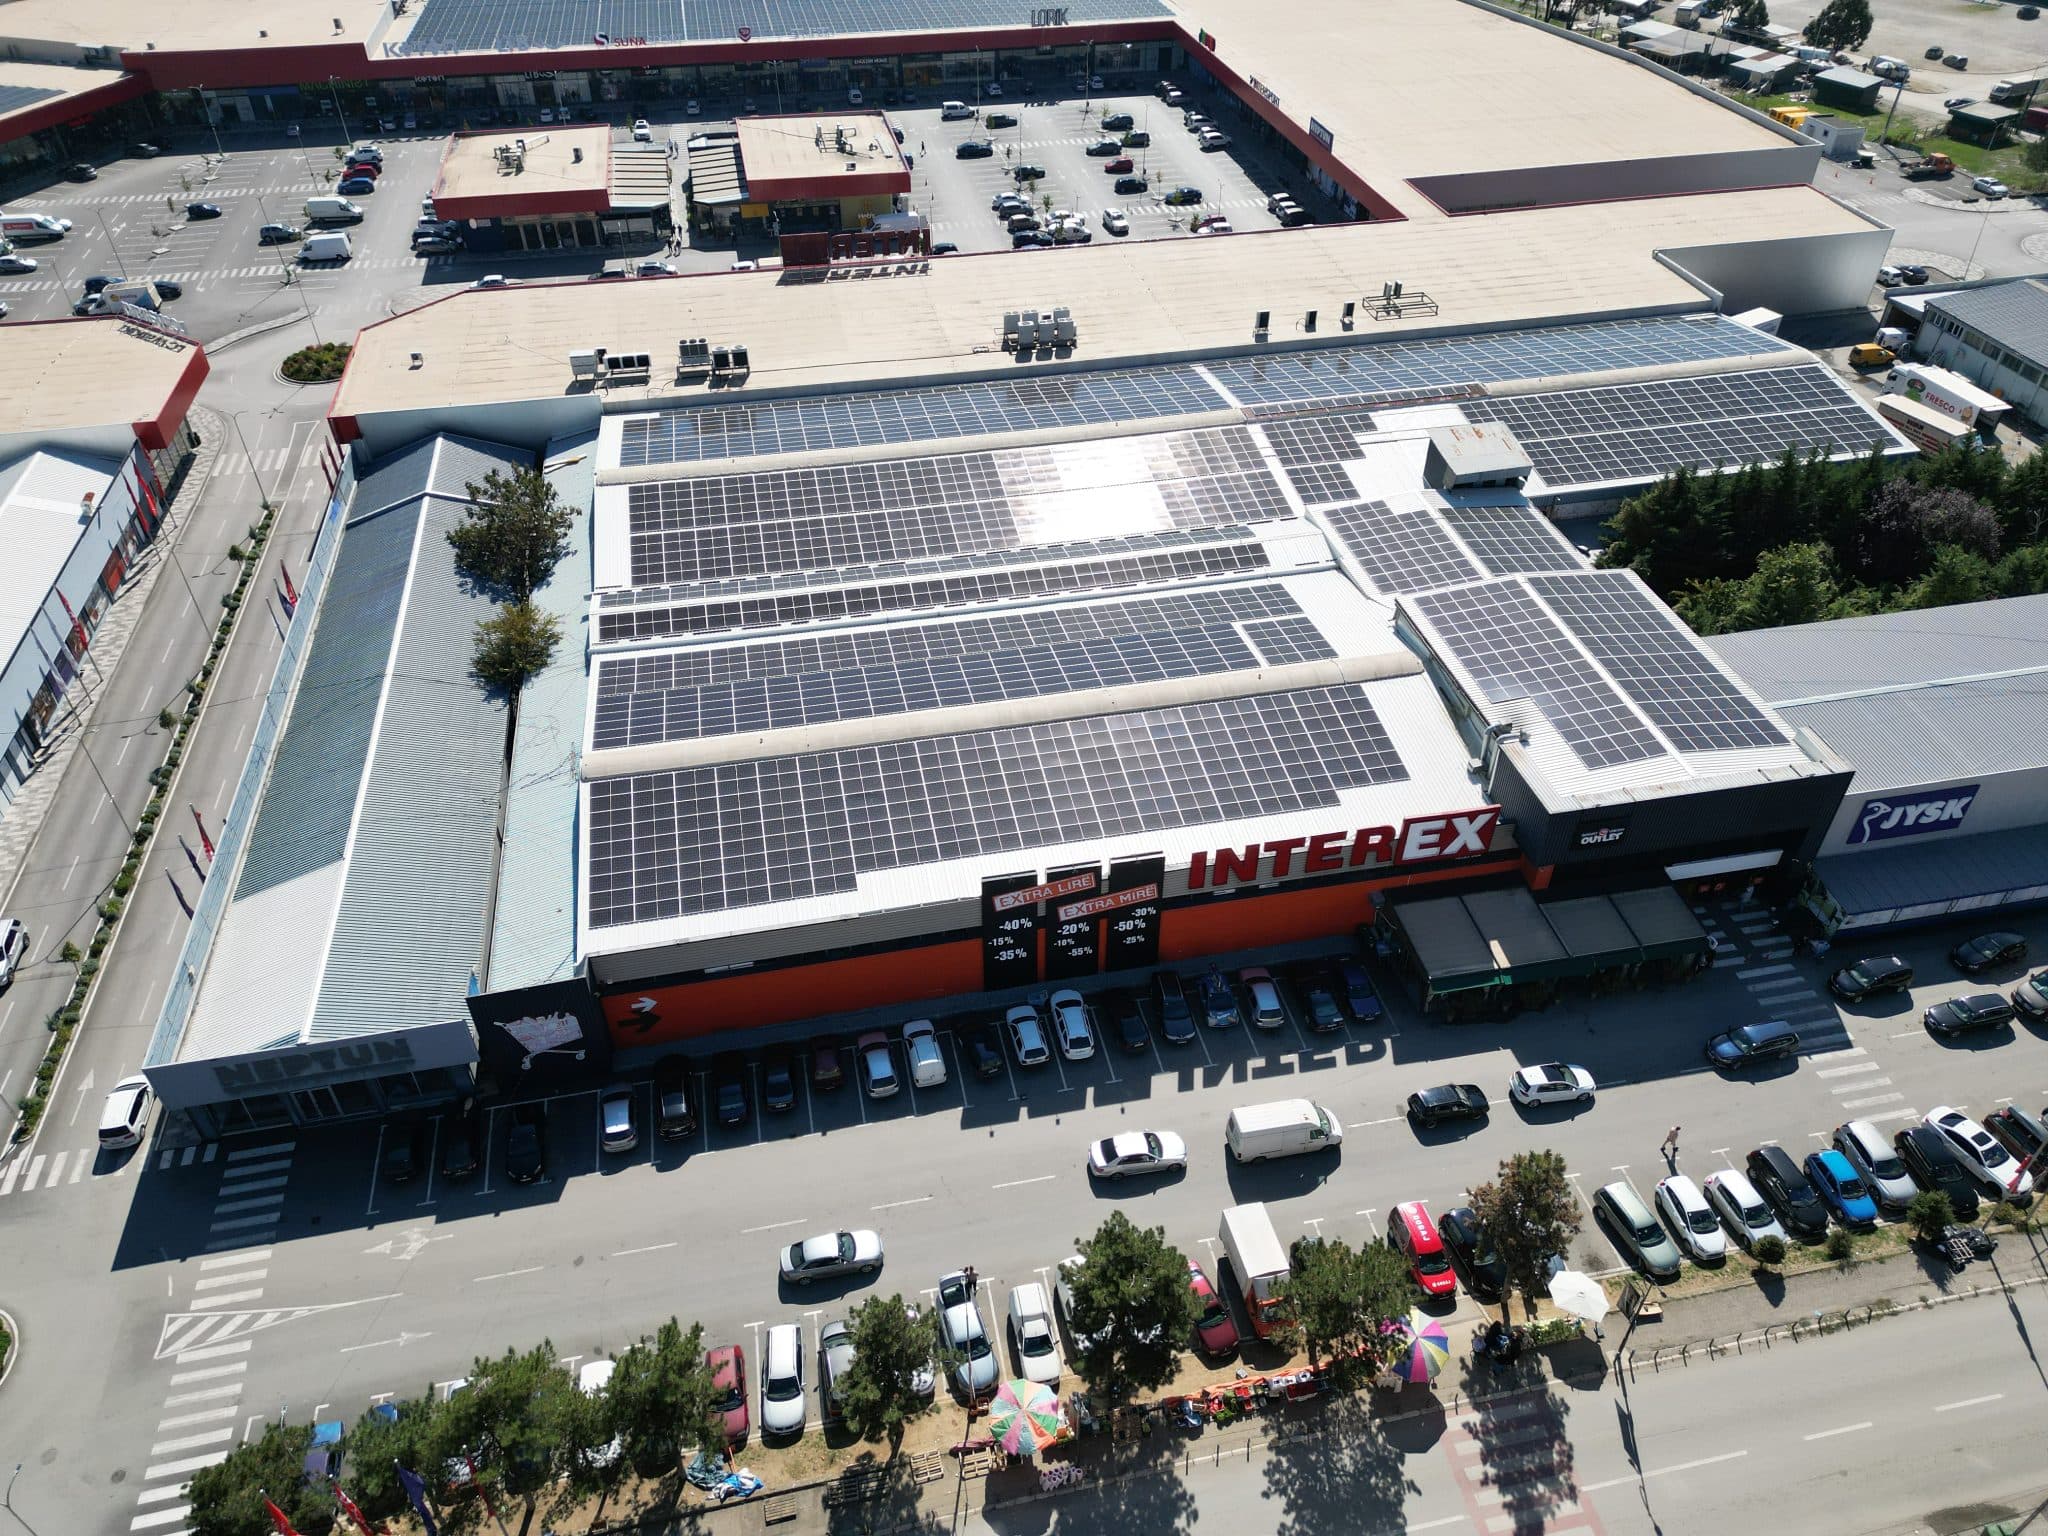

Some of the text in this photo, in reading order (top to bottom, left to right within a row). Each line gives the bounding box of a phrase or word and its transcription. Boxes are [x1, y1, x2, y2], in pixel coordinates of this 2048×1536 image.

[1031, 7, 1069, 28] LORIK
[614, 36, 647, 47] SUNA
[1925, 391, 1955, 414] FRESCO
[1879, 796, 1973, 830] JYSK
[1188, 812, 1495, 890] INTEREX
[999, 888, 1053, 908] EXTRA
[1064, 899, 1116, 918] EXTRA
[1131, 906, 1157, 917] -30%
[998, 917, 1033, 931] -40%
[1057, 922, 1090, 935] -20%
[1113, 919, 1146, 932] -50%
[988, 936, 1014, 947] -15%
[994, 947, 1028, 961] -35%
[1067, 946, 1093, 957] -55%
